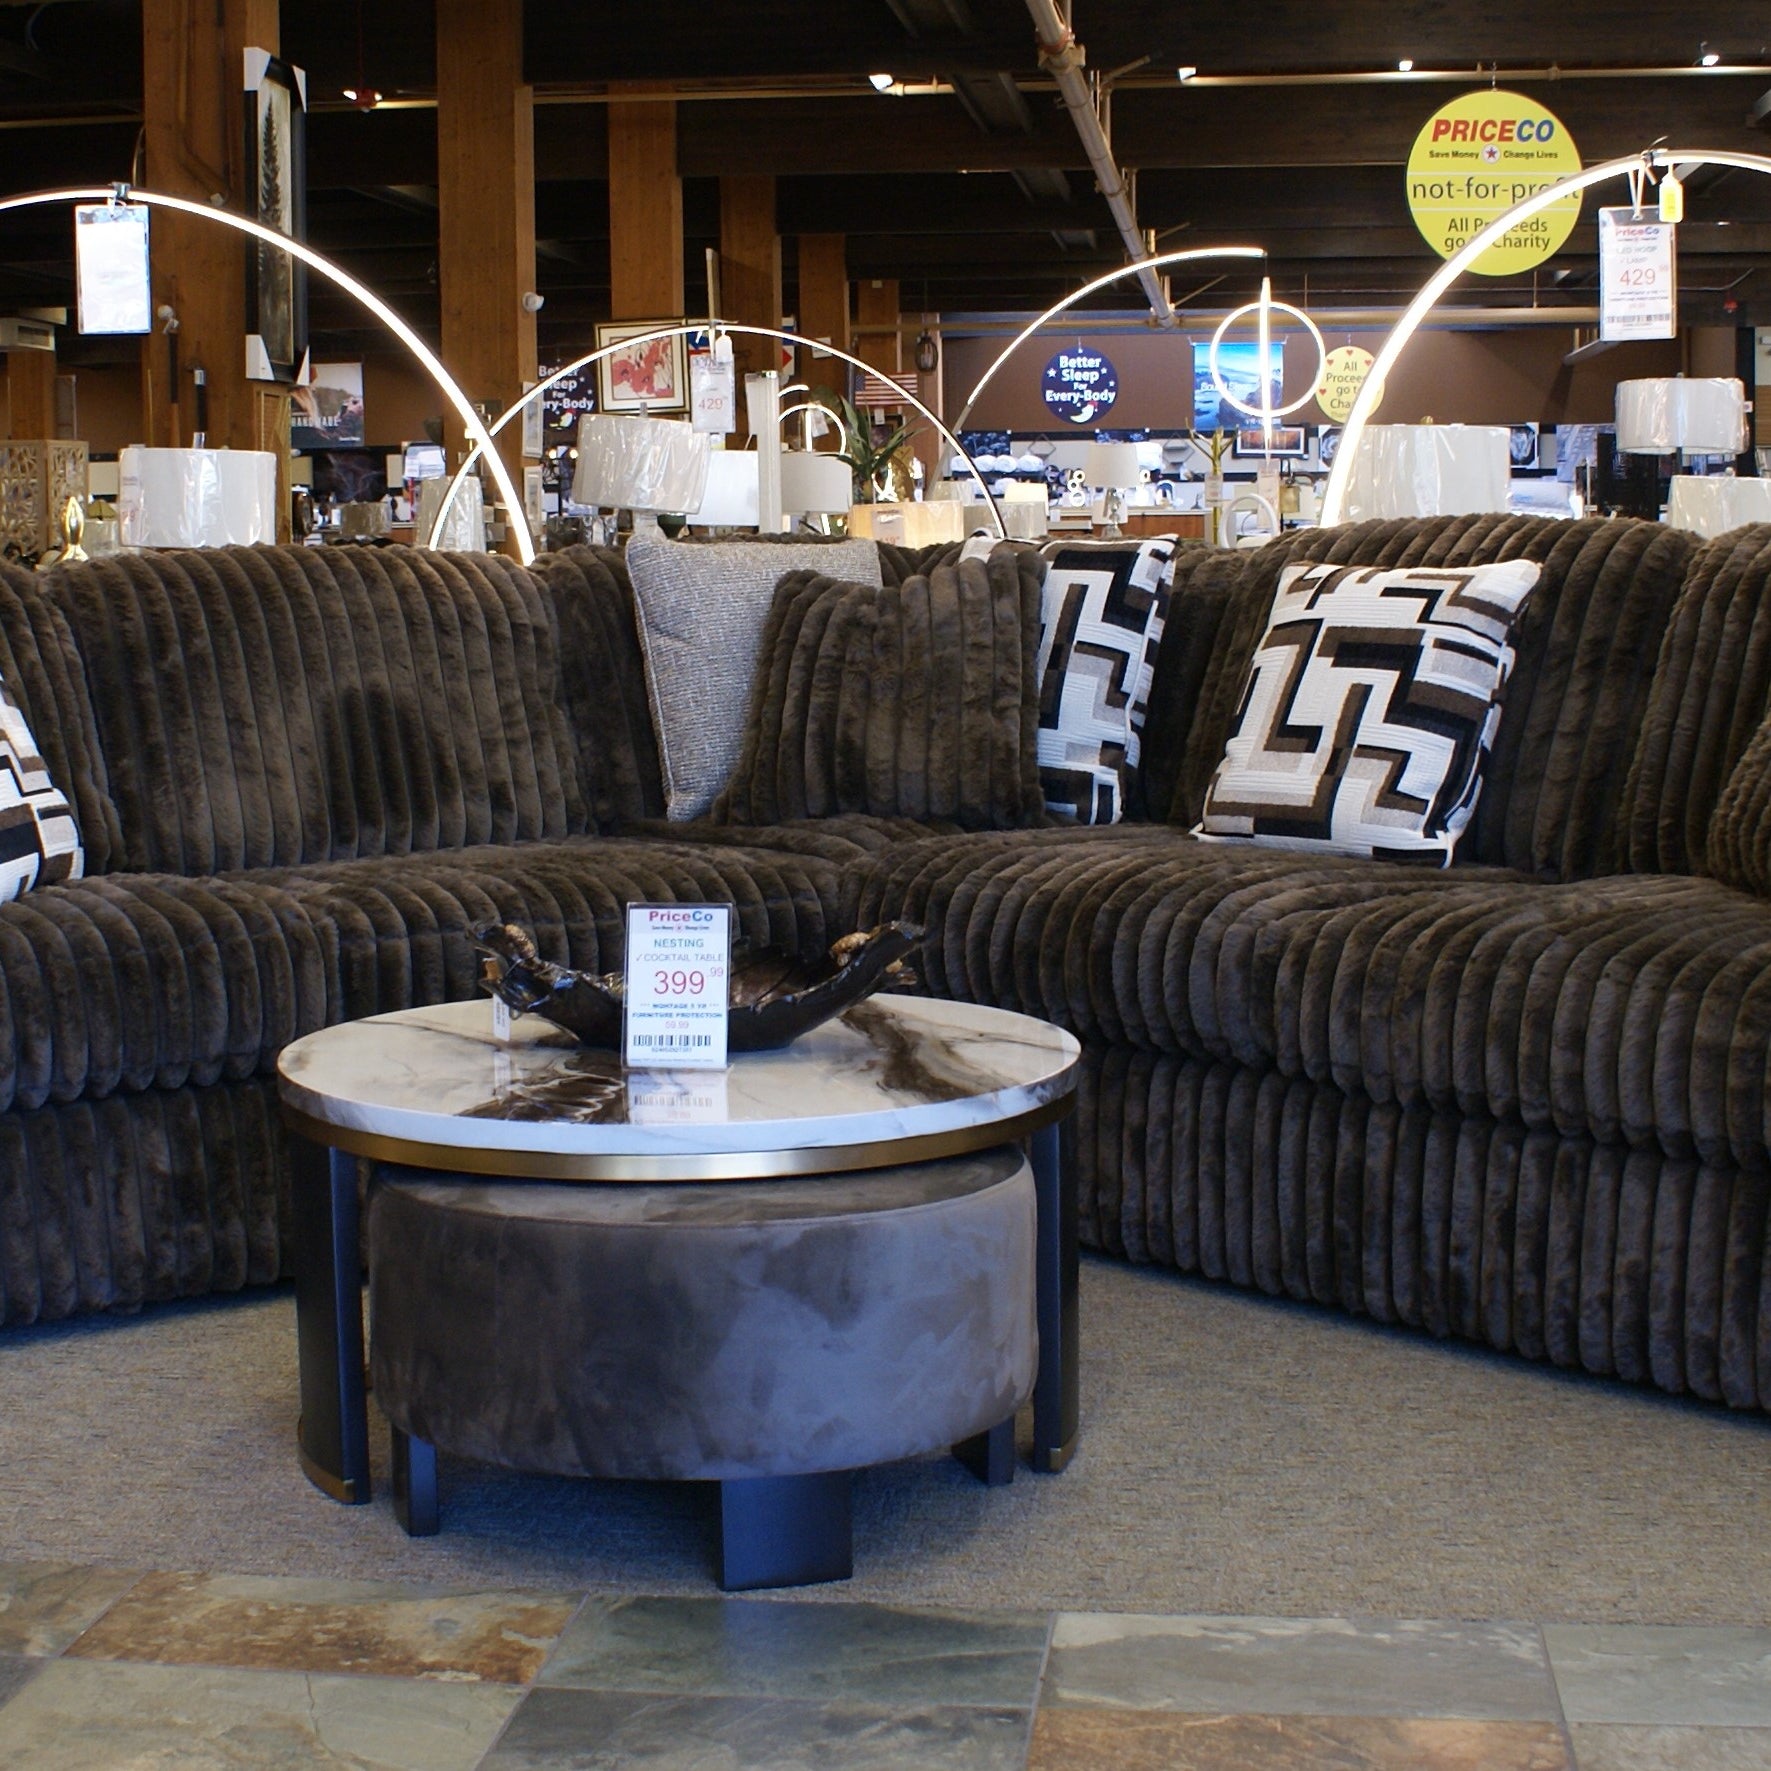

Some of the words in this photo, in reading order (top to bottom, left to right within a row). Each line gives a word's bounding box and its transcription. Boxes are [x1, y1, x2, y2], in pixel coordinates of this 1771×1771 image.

[1432, 119, 1555, 143] PRICECO
[1429, 150, 1450, 159] Save
[1452, 150, 1479, 160] Money
[1503, 150, 1535, 160] Change
[1537, 150, 1558, 159] Lives
[1448, 217, 1469, 232] All
[1474, 217, 1548, 232] Preeds
[1444, 237, 1466, 252] go
[1619, 268, 1656, 286] 429
[1059, 355, 1102, 369] Better
[1343, 361, 1358, 371] All
[1061, 368, 1100, 385] Sleep
[1326, 372, 1363, 383] Procee
[1073, 382, 1088, 390] For
[1336, 386, 1351, 396] go
[1045, 389, 1116, 404] Every-Body
[698, 398, 723, 410] 429
[649, 911, 713, 922] PriceCo
[654, 938, 704, 948] NESTING
[644, 953, 690, 961] COCKTAIL
[695, 953, 724, 961] TABLE
[654, 970, 705, 995] 399
